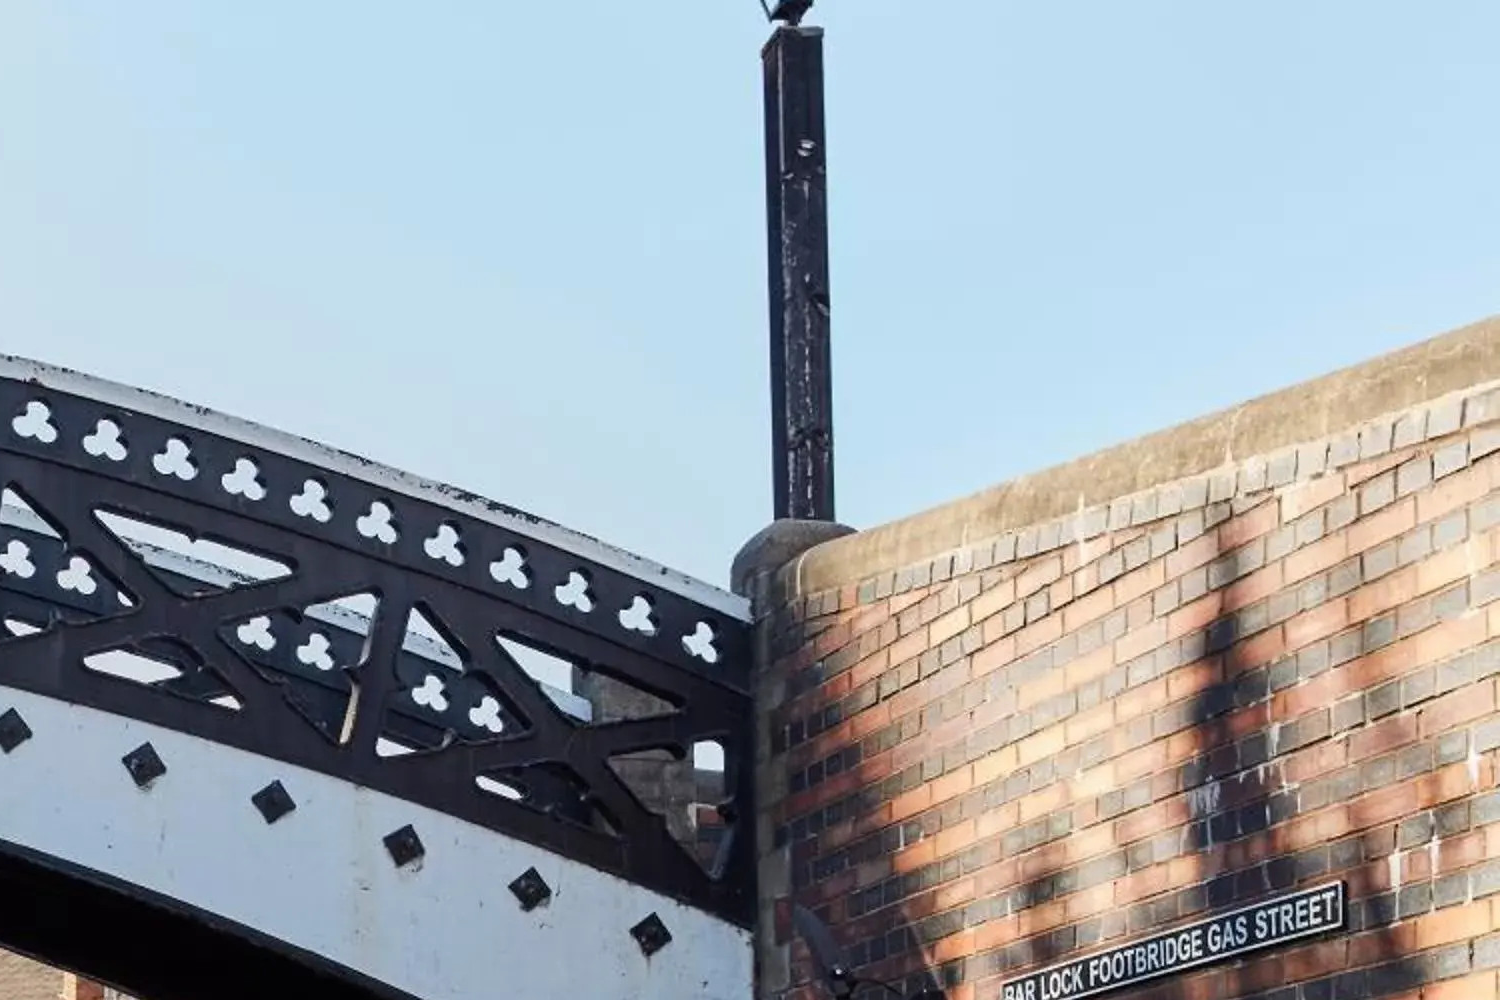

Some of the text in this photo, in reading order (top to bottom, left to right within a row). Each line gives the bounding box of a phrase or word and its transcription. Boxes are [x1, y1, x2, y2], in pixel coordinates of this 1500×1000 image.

[1040, 964, 1084, 1000] LOCK
[1089, 928, 1203, 987] FOOTBRIDGE
[1207, 915, 1248, 952] GAS
[1255, 890, 1335, 939] STREET
